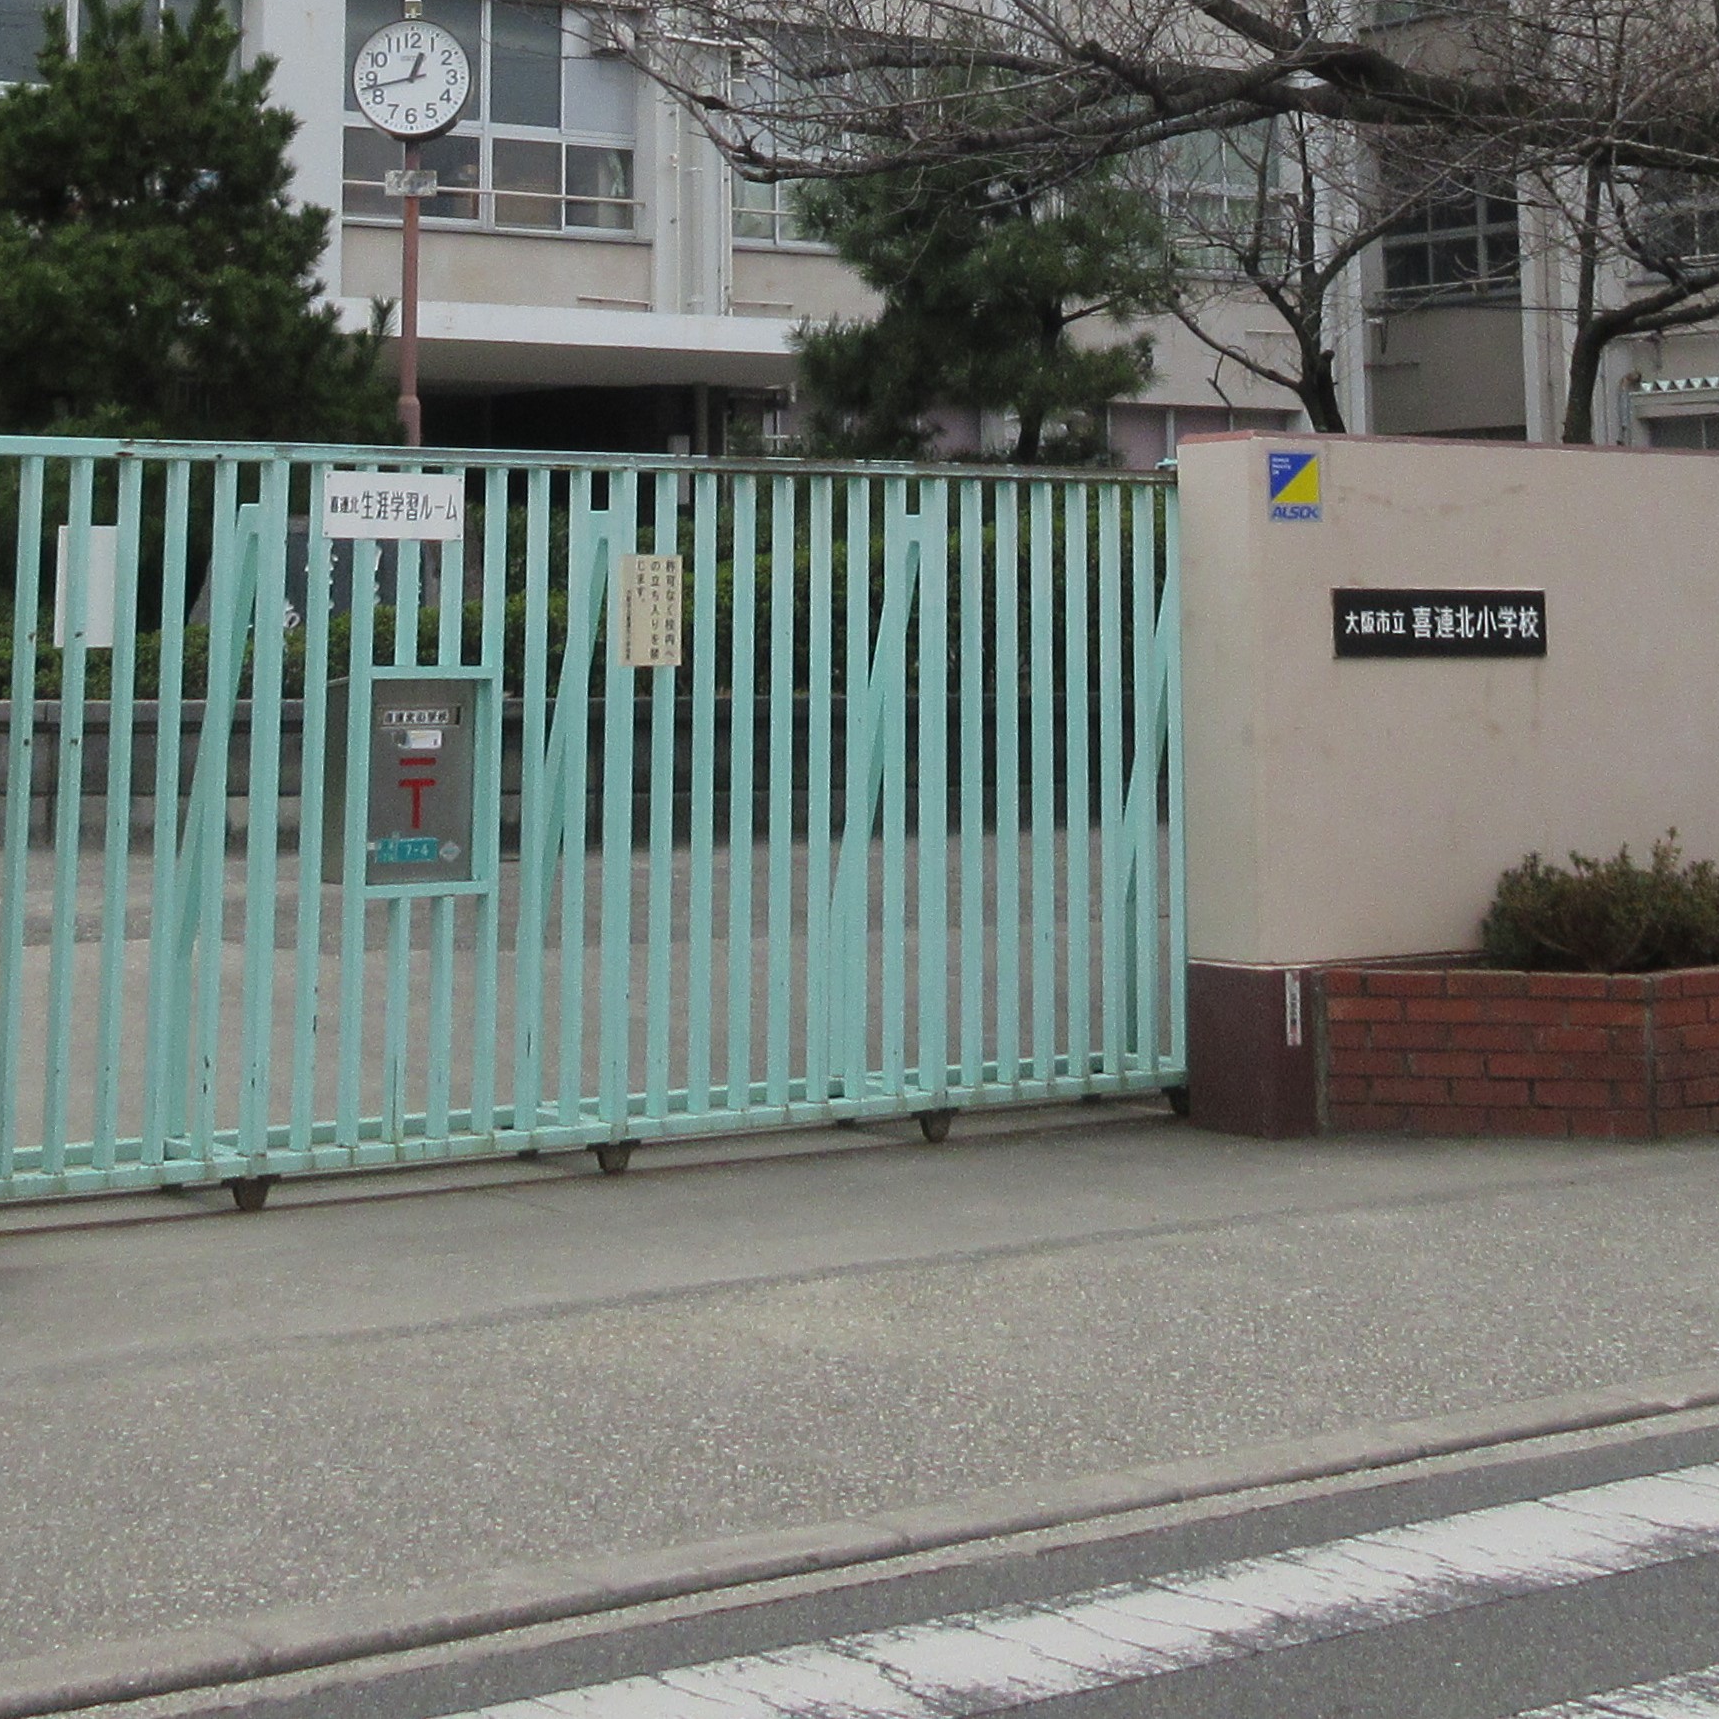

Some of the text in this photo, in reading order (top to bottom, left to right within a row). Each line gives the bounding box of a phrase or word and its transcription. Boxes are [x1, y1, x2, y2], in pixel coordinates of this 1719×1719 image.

[387, 36, 400, 53] 11
[405, 33, 422, 48] 12
[430, 36, 434, 52] 1
[369, 52, 388, 68] 10
[441, 50, 453, 65] 2
[365, 71, 377, 87] 9
[446, 69, 458, 85] 3
[372, 89, 385, 104] 8
[440, 88, 452, 104] 4
[387, 104, 399, 119] 7
[405, 108, 417, 124] 6
[425, 103, 437, 118] 5
[361, 490, 458, 521] 生涯学習ルーム
[1272, 506, 1319, 520] ALSOK
[1344, 605, 1540, 639] 大阪市立 喜連北小学校
